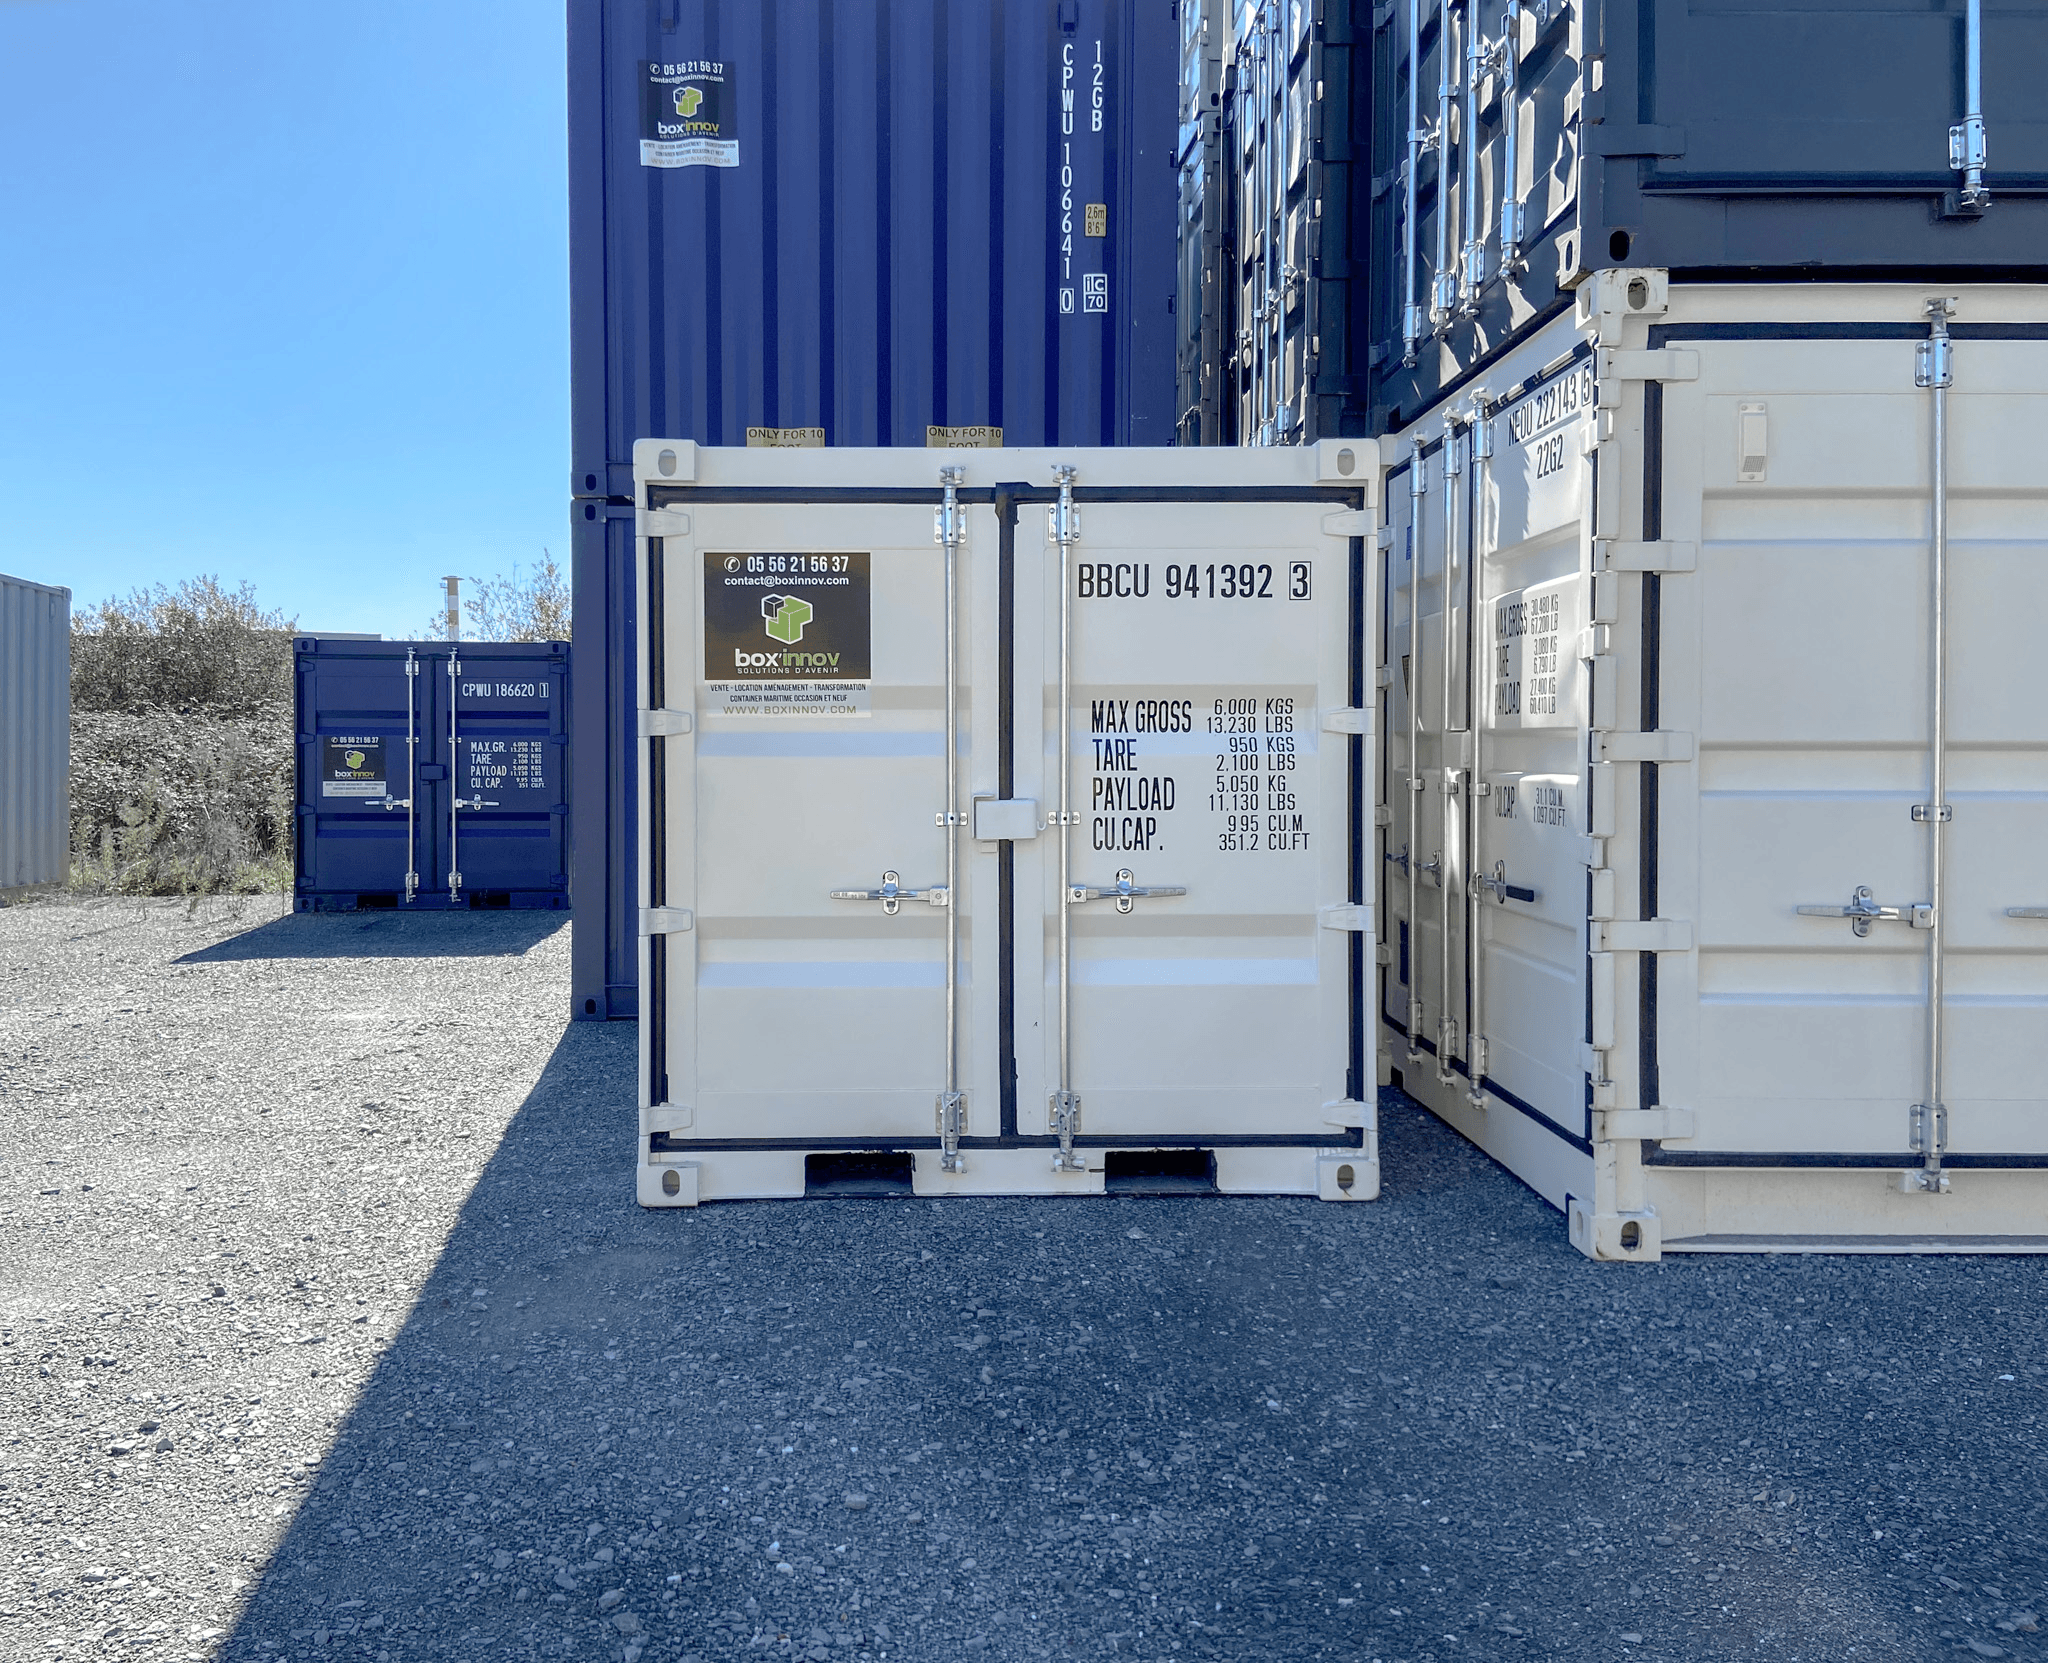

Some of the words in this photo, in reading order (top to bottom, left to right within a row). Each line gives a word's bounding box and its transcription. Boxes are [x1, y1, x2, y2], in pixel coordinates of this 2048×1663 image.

[664, 64, 674, 76] 05
[676, 63, 686, 74] 56
[688, 61, 698, 72] 21
[700, 60, 710, 72] 56
[712, 62, 723, 74] 37
[650, 74, 724, 84] contact@boxinnov.com
[1091, 40, 1103, 132] 12GB
[1062, 44, 1074, 134] CPWU
[1062, 142, 1072, 280] 106641
[1088, 296, 1104, 308] 70
[1508, 401, 1532, 446] NEOU
[1537, 374, 1576, 430] 222143
[1583, 362, 1590, 404] 5
[748, 429, 779, 439] ONLY
[784, 429, 806, 439] FOR
[810, 429, 823, 438] 10
[929, 427, 959, 438] ONLY
[962, 428, 986, 438] FOR
[990, 429, 1001, 438] 10
[1537, 434, 1564, 479] 22G2
[747, 556, 764, 572] 05
[768, 556, 786, 572] 56
[790, 556, 806, 572] 21
[810, 556, 828, 572] 56
[832, 556, 849, 572] 37
[724, 576, 849, 587] contact@boxinnov.com
[1078, 563, 1150, 598] BBCU
[1165, 564, 1273, 598] 941392
[1291, 563, 1308, 598] 3
[1551, 594, 1558, 612] KG
[1551, 613, 1558, 631] LB
[1550, 636, 1557, 653] KG
[1550, 655, 1556, 672] LB
[462, 684, 491, 696] CPWU
[495, 684, 534, 697] 186620
[1549, 677, 1556, 694] KG
[1266, 698, 1293, 714] KGS
[1495, 682, 1520, 715] PAYLOAD
[1549, 696, 1555, 714] LB
[723, 706, 857, 714] WWW.BOXINNOV.COM
[1092, 700, 1129, 733] MAX
[1136, 700, 1192, 733] GROSS
[1266, 716, 1293, 733] LBS
[470, 742, 507, 752] MAX.GR.
[1229, 737, 1258, 752] 950
[1267, 737, 1295, 752] KGS
[471, 754, 492, 764] TARE
[1092, 738, 1138, 771] TARE
[1268, 754, 1295, 771] LBS
[470, 766, 507, 776] PAYLOAD
[485, 778, 503, 788] CAP.
[1268, 775, 1285, 792] KG
[1093, 777, 1175, 811] PAYLOAD
[1268, 793, 1295, 810] LBS
[1228, 815, 1258, 832] 995
[1268, 814, 1302, 832] CU.M
[1219, 834, 1258, 850] 351.2
[1268, 833, 1310, 850] CU.FT
